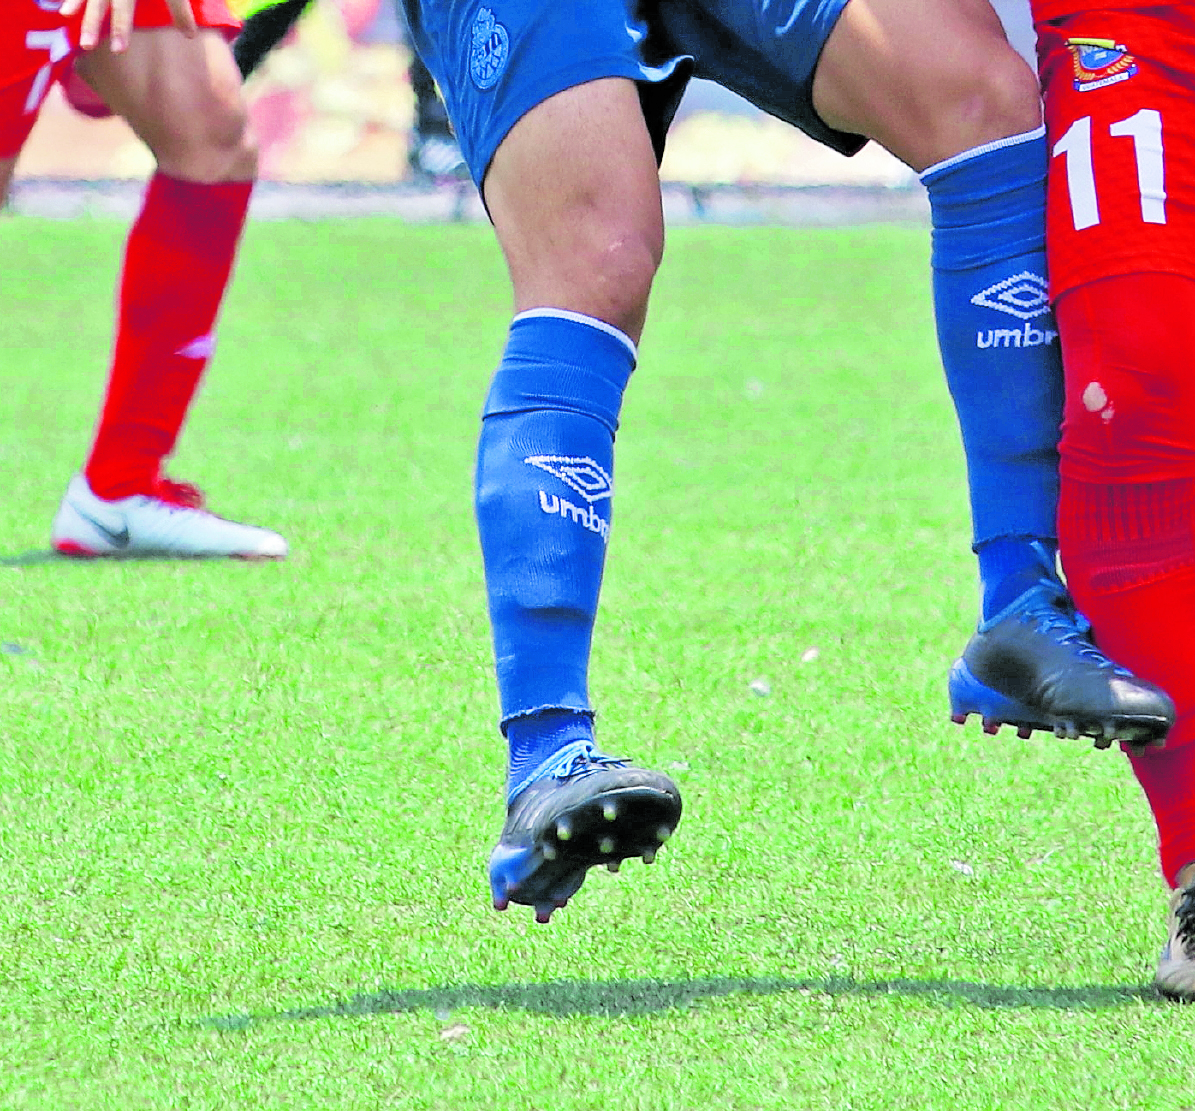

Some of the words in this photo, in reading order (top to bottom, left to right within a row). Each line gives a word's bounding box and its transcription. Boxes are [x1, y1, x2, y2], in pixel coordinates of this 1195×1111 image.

[24, 26, 71, 116] 7
[1052, 108, 1168, 232] 11
[977, 322, 1059, 349] umbr
[539, 490, 610, 545] umbr
